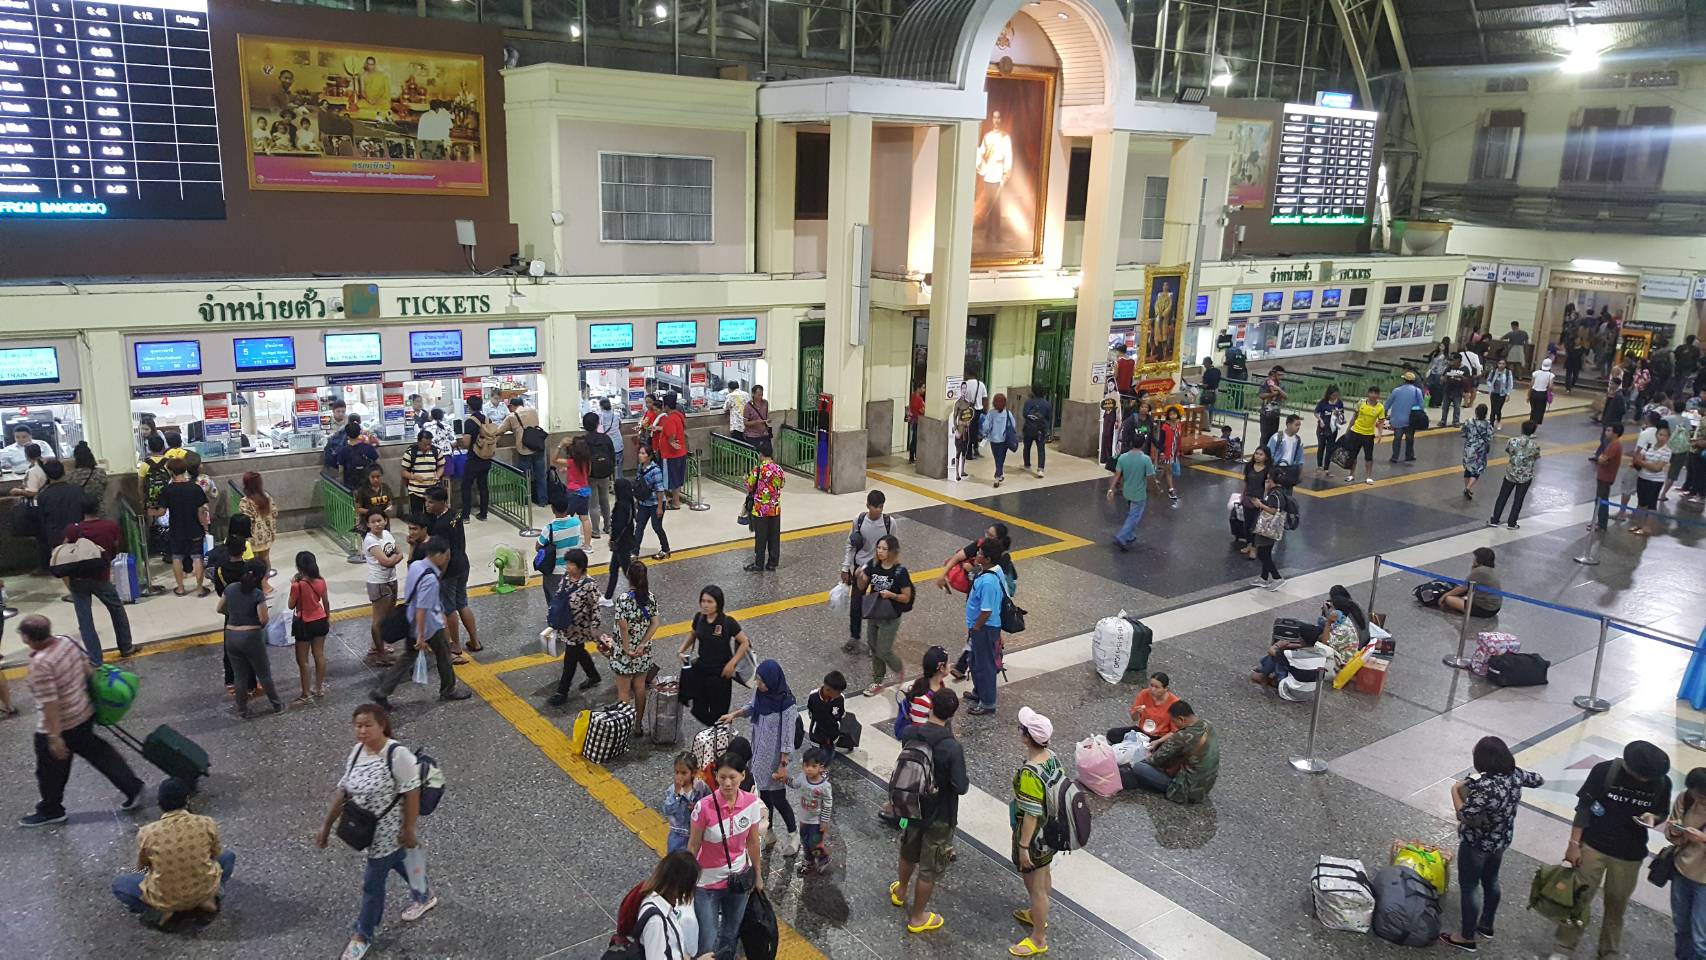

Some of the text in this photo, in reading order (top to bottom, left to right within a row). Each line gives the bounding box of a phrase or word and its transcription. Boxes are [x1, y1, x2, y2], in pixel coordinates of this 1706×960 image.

[198, 287, 326, 323] จำหน่ายตั๋ว
[397, 294, 491, 316] TICKETS
[243, 348, 249, 356] 5
[346, 384, 353, 392] 6
[160, 396, 168, 406] 4
[19, 406, 28, 416] 3
[1608, 792, 1629, 802] HOLY
